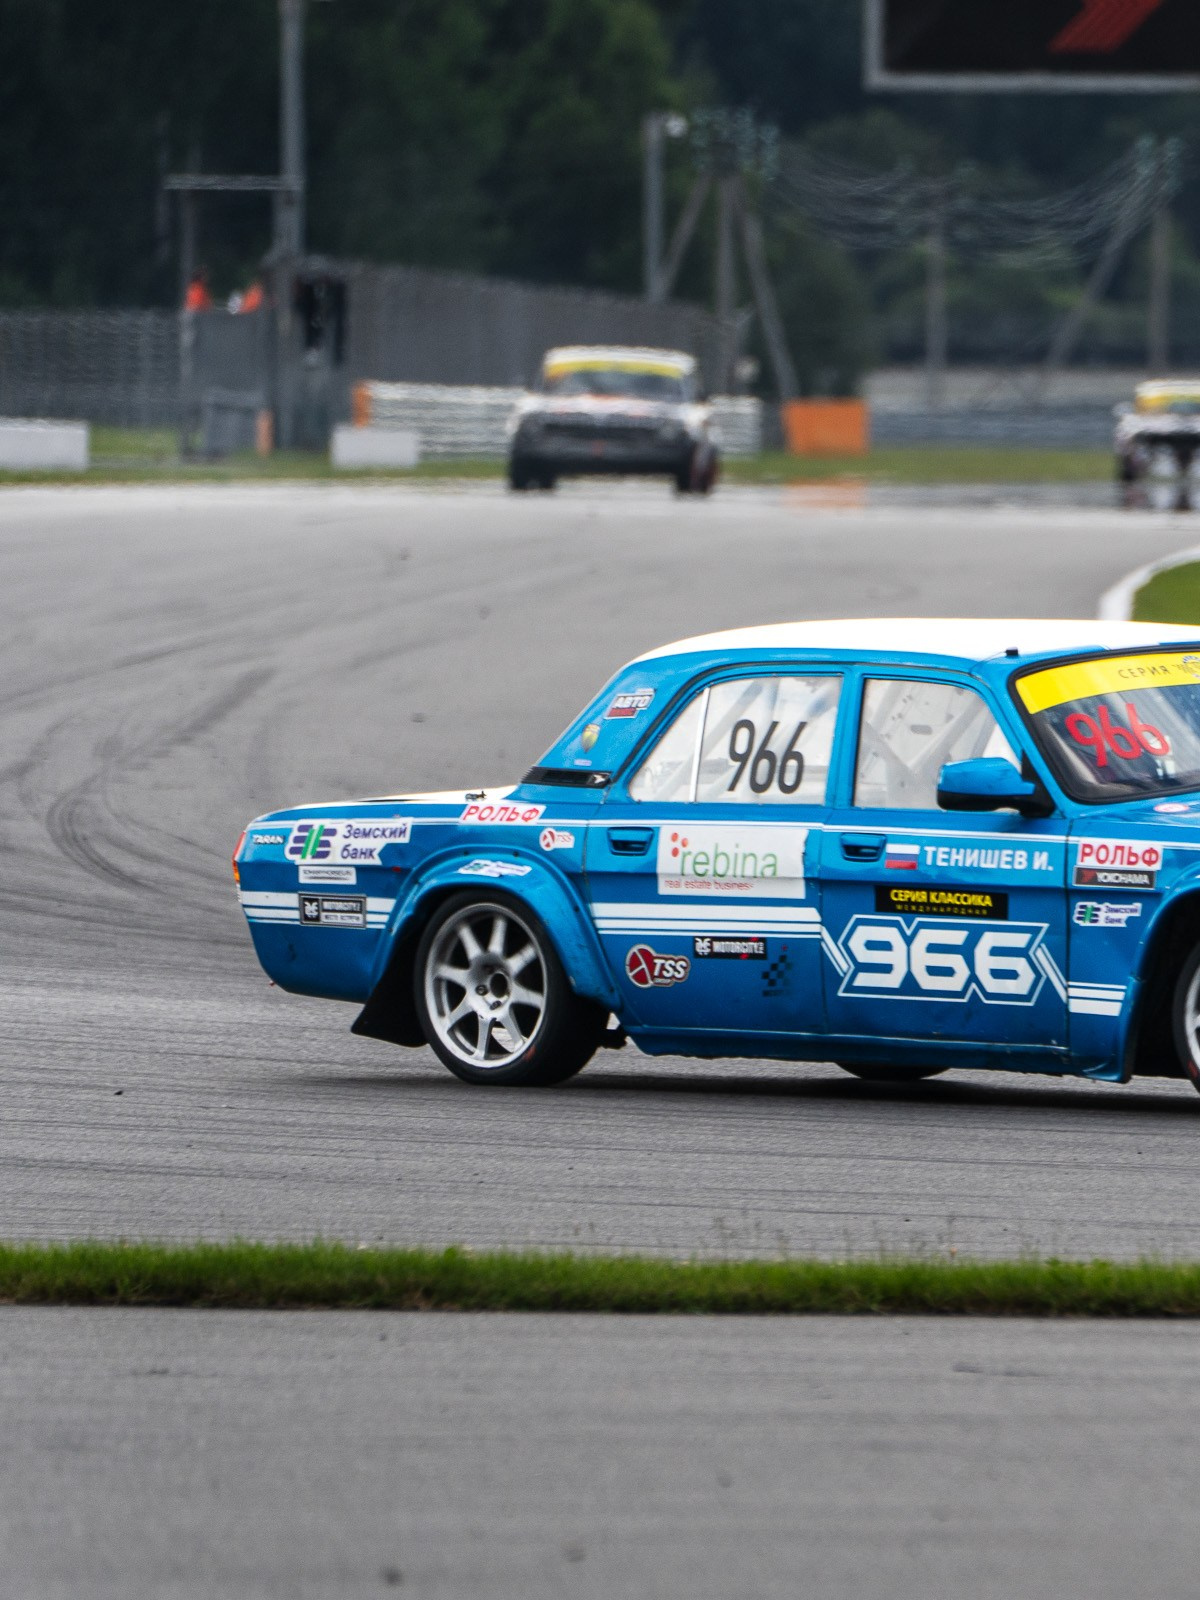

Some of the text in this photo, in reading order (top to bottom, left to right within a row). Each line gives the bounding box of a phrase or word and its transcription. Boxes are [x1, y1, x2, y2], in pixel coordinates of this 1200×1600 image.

[1118, 665, 1169, 679] СЕРИЯ
[1065, 703, 1170, 767] 966
[728, 719, 807, 794] 966
[462, 805, 541, 822] РОЛЬФ
[343, 824, 408, 840] Земский
[341, 844, 377, 860] банк
[681, 843, 778, 878] rebina
[924, 846, 1054, 871] ТЕНИШЕВ И.
[1080, 843, 1160, 867] РОЛЬФ
[1096, 871, 1150, 885] YOKOHAMA
[890, 889, 993, 908] СЕРИЯ КЛАССИКА
[654, 959, 687, 979] TSS
[849, 926, 1036, 994] 966
